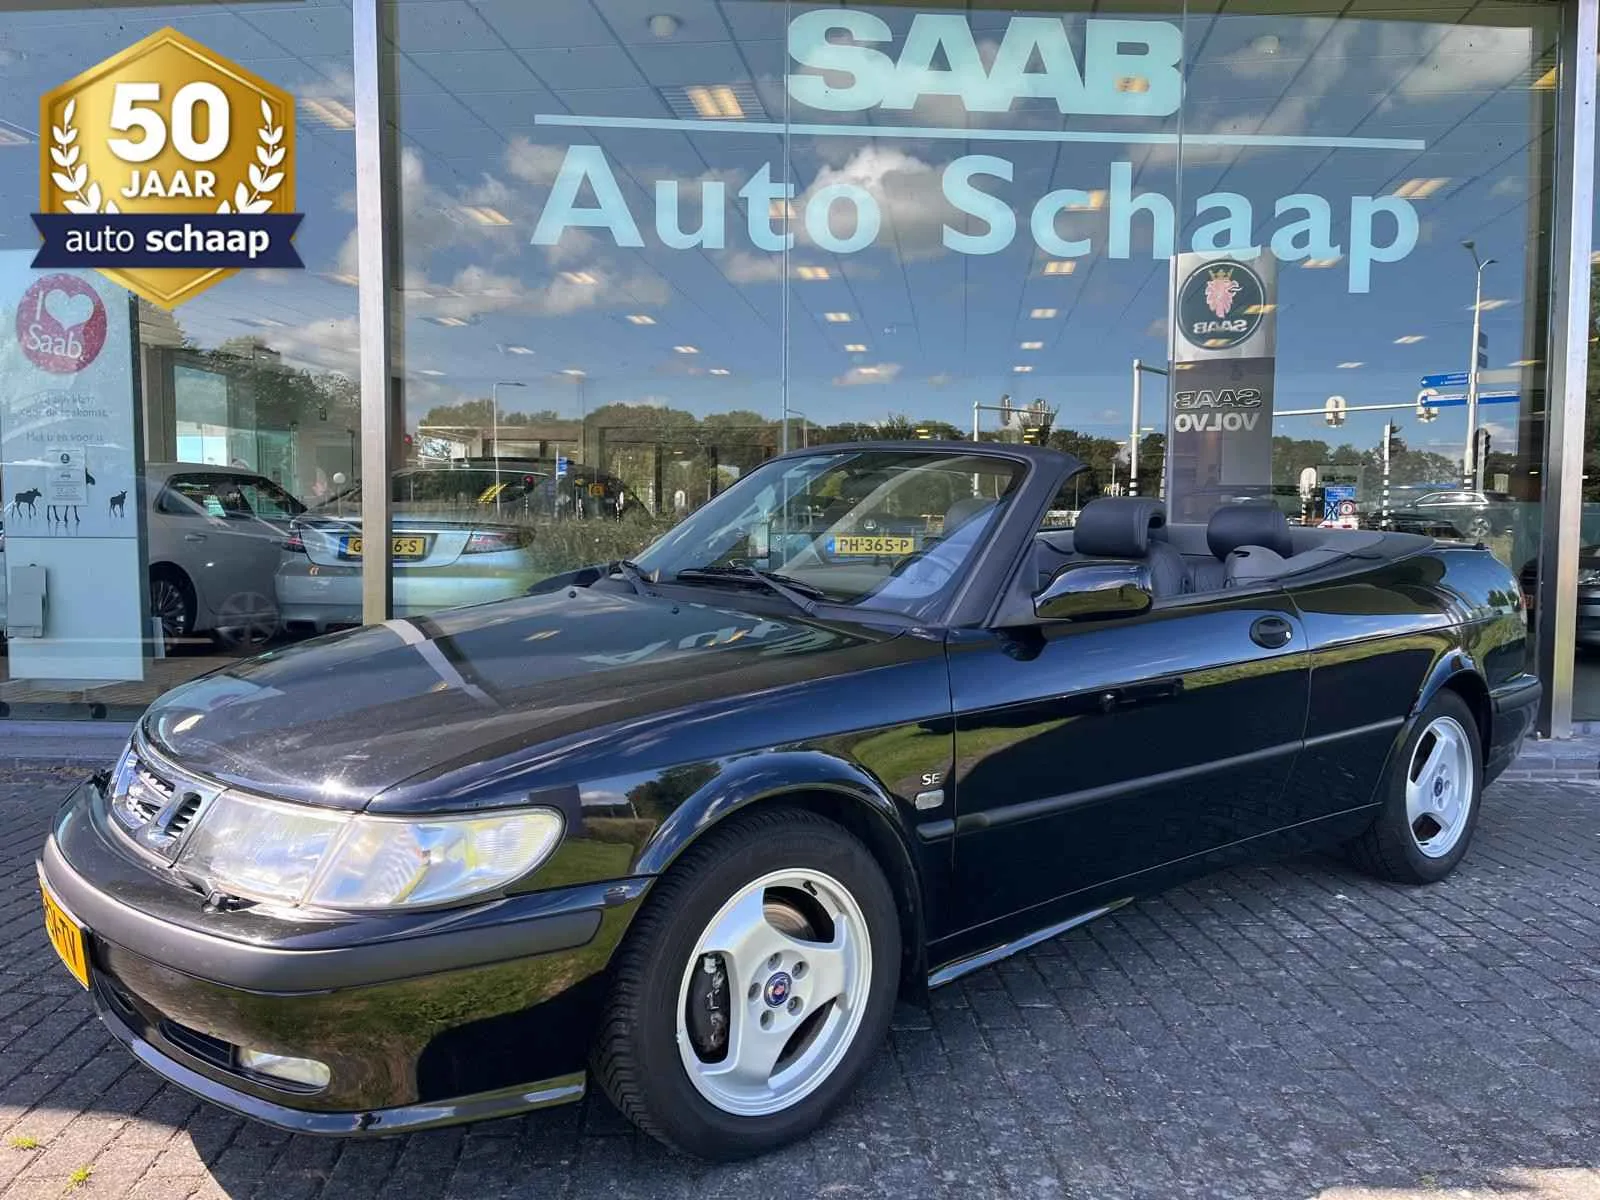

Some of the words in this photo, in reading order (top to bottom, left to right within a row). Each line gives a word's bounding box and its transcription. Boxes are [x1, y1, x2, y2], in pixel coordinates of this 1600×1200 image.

[784, 9, 1185, 117] SAAB
[530, 145, 881, 254] Auto
[942, 155, 1420, 293] Schaap
[839, 538, 910, 553] PH-365-P
[921, 773, 942, 786] SE
